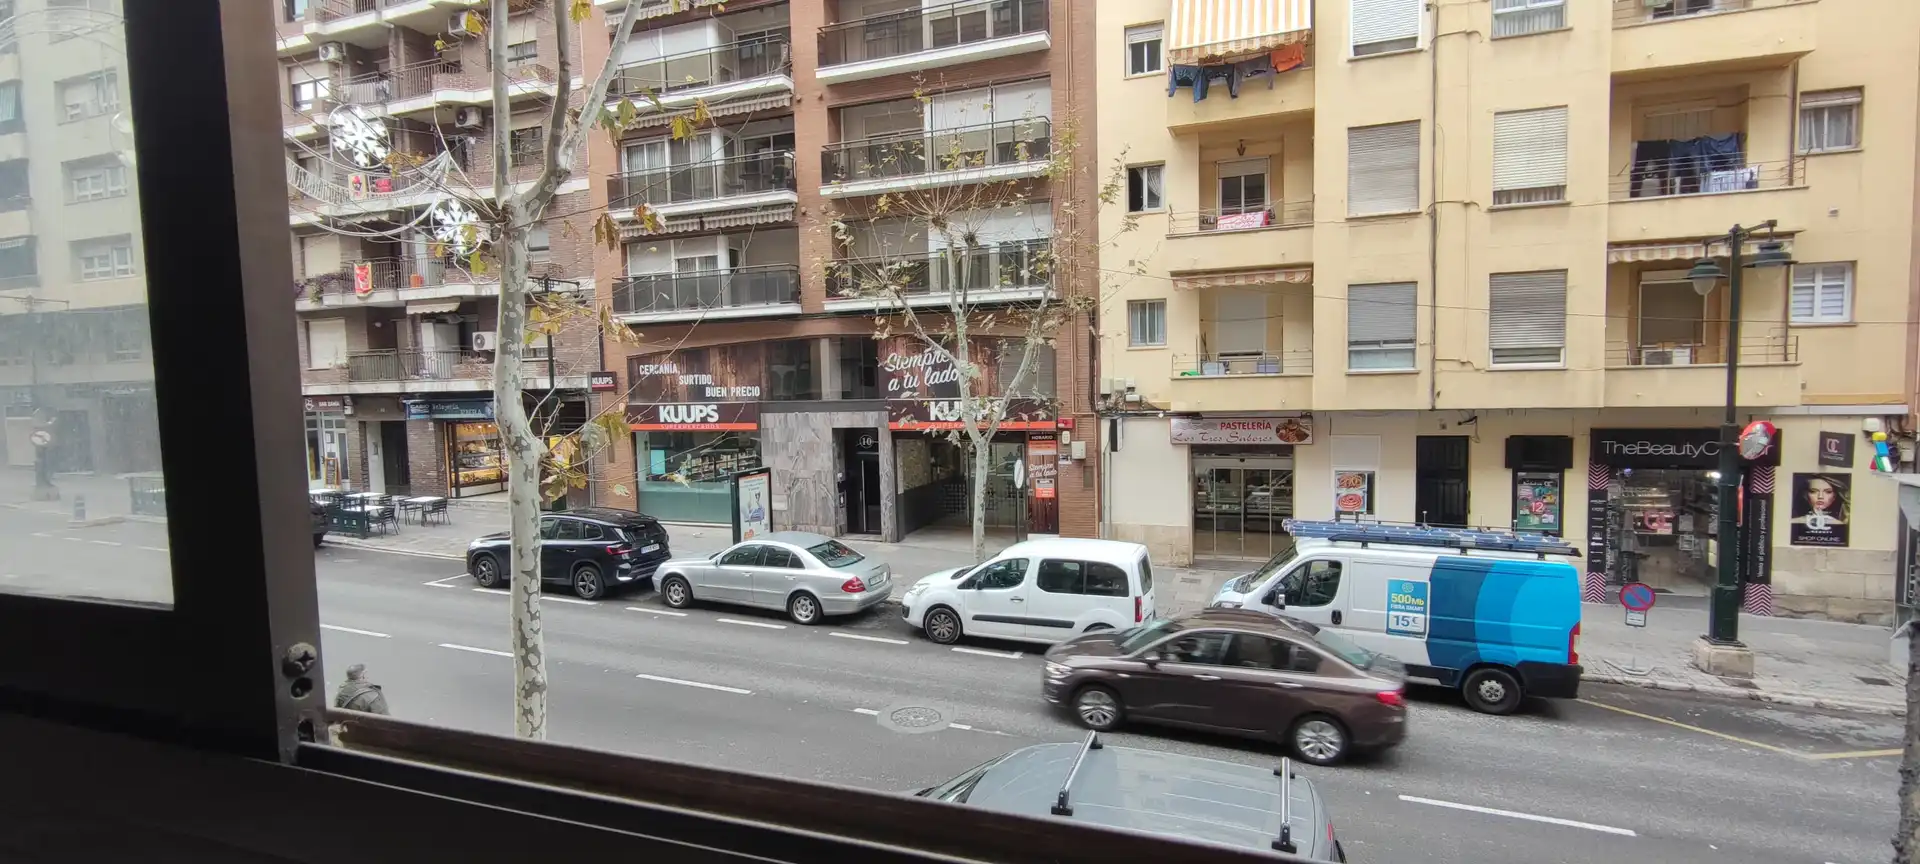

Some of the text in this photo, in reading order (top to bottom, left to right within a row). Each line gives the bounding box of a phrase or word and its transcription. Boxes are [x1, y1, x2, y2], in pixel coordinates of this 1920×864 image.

[884, 349, 951, 373] Siempre
[639, 361, 681, 375] CERCANÍA,
[592, 376, 613, 385] KUUPS
[679, 374, 715, 386] SURTIDO,
[887, 363, 960, 392] a tu lado
[705, 385, 760, 398] BUEN PRECIO
[659, 404, 720, 423] KUUPS
[1220, 420, 1272, 431] PASTELERÍA
[862, 437, 872, 446] 10
[1172, 432, 1195, 442] Los
[1199, 431, 1222, 442] Tres
[1531, 501, 1544, 513] 12
[1816, 535, 1841, 543] ONLINE
